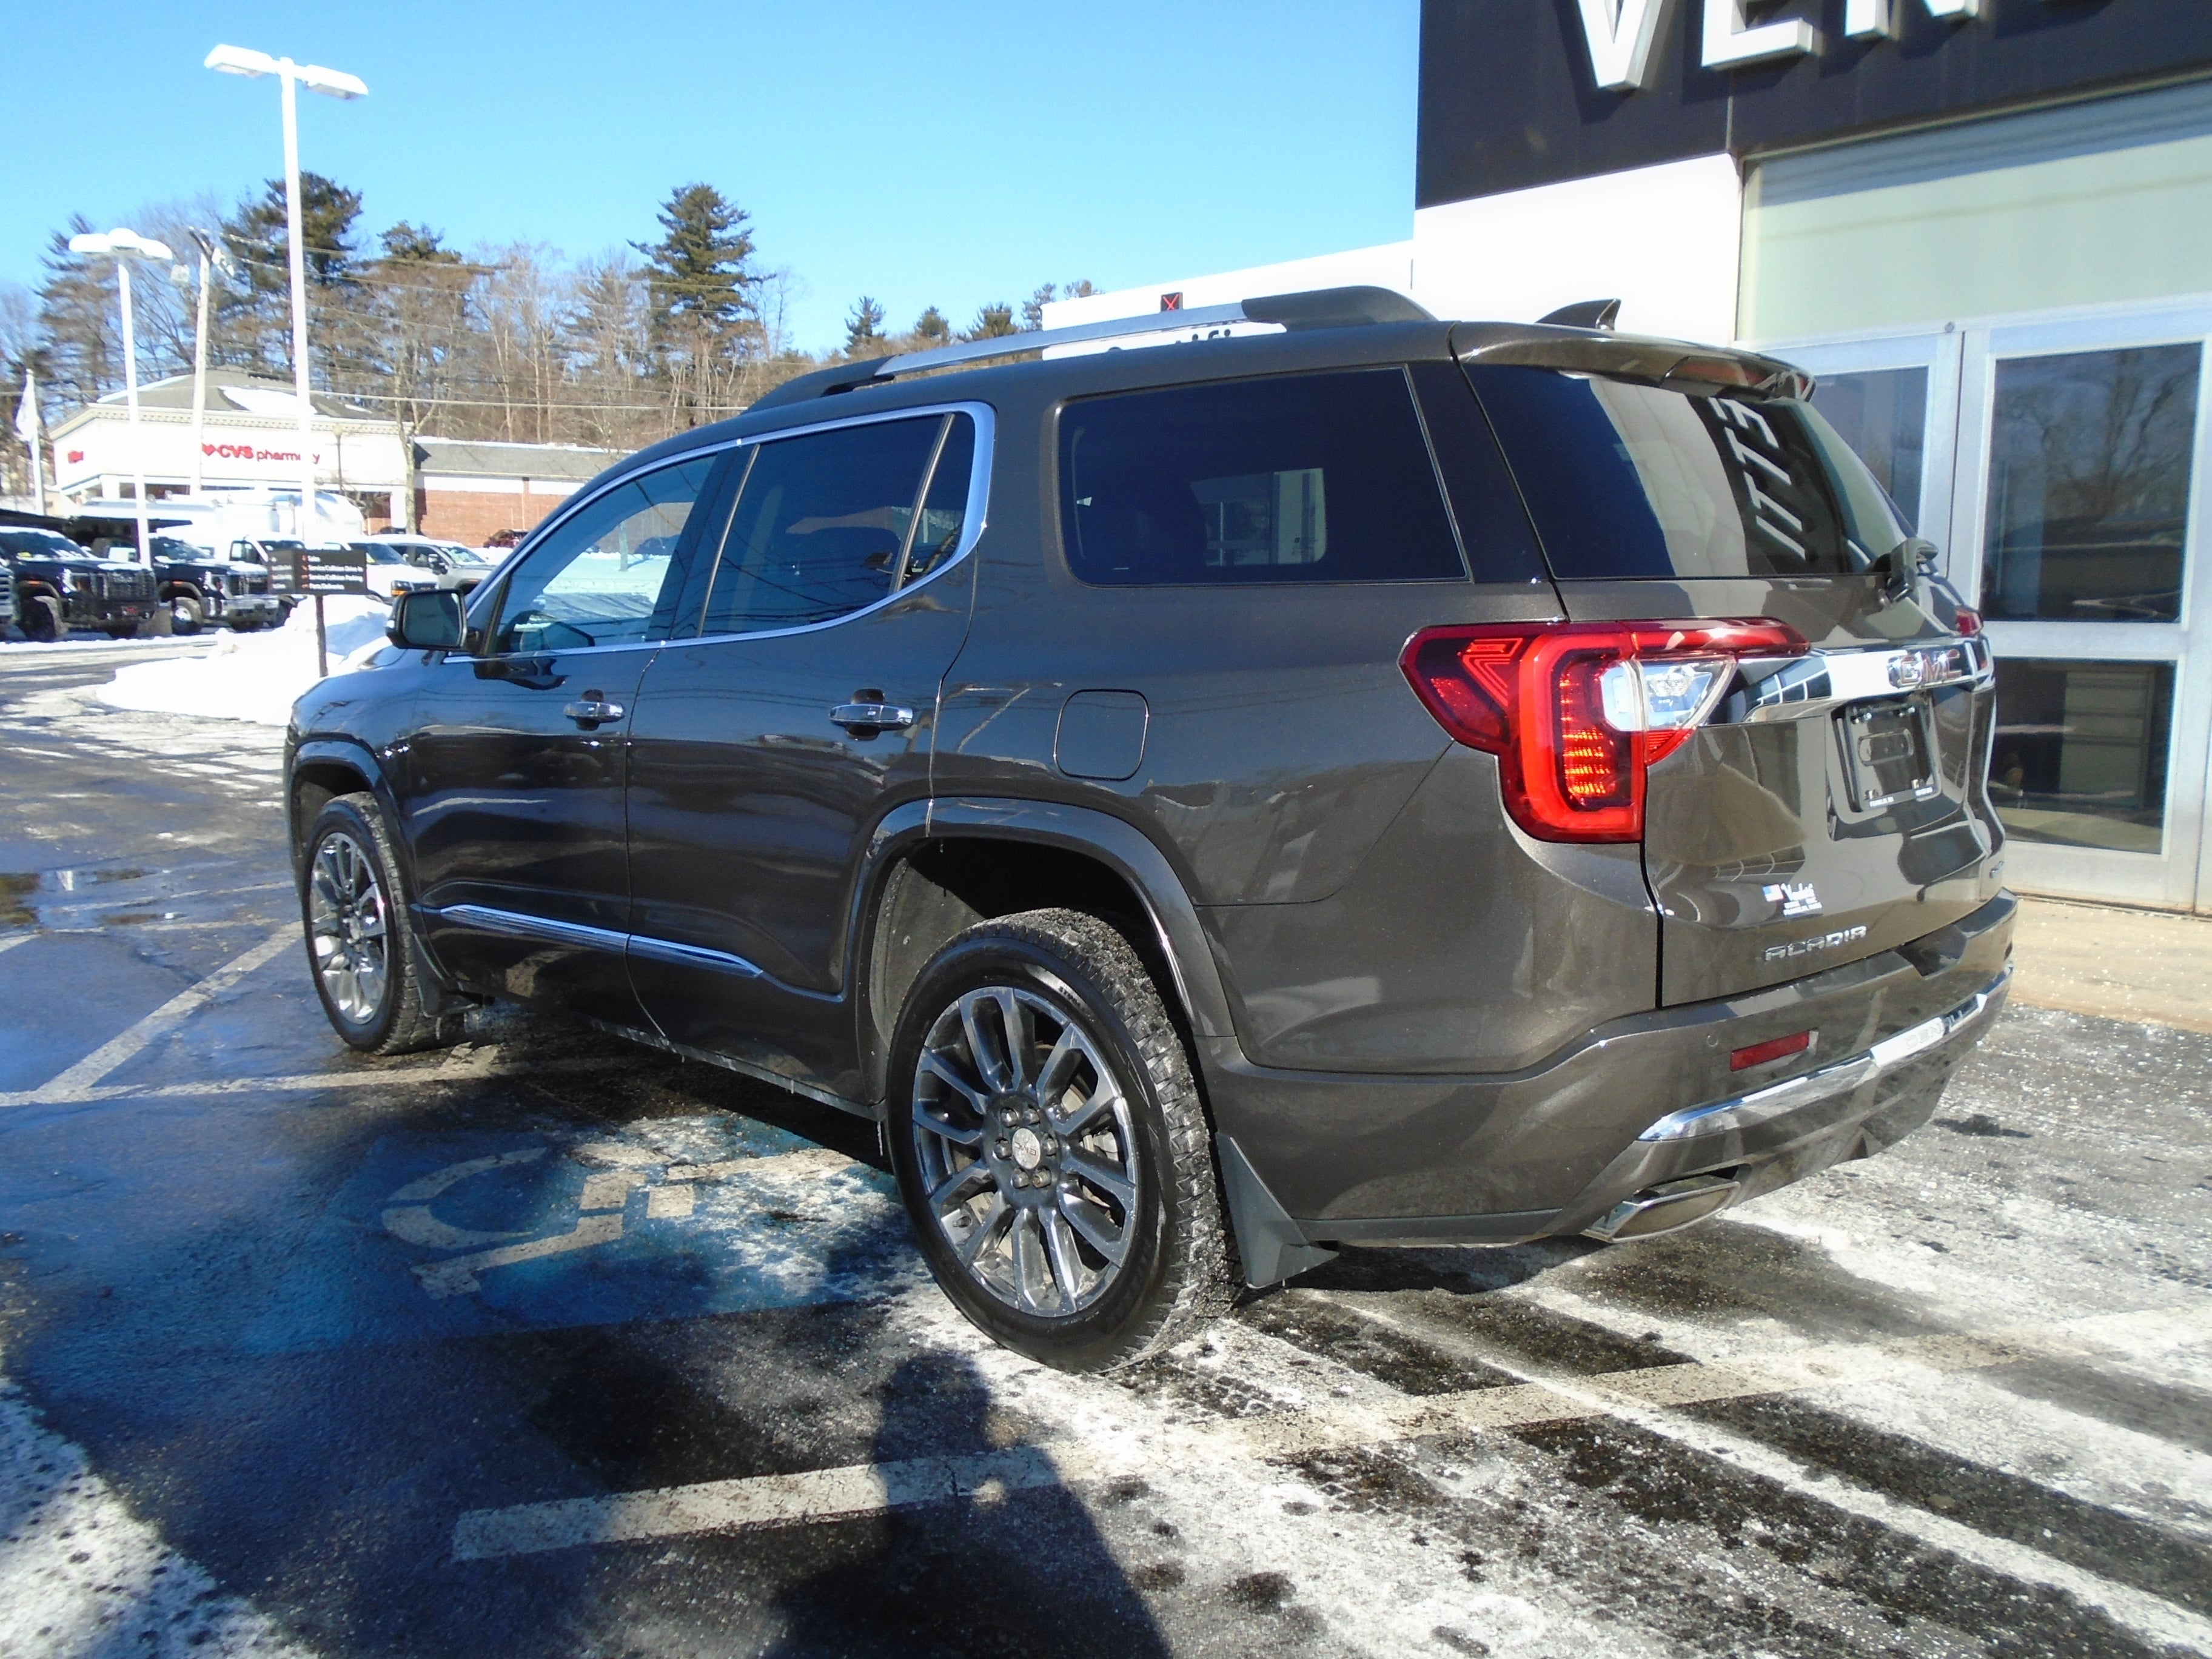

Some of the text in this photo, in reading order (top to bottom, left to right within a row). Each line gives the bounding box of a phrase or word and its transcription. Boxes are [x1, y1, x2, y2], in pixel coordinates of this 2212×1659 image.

[217, 444, 320, 464] CVS pharmy
[1887, 648, 1962, 688] GMC
[1765, 925, 1867, 962] ACADIA
[1014, 1141, 1037, 1156] GMC
